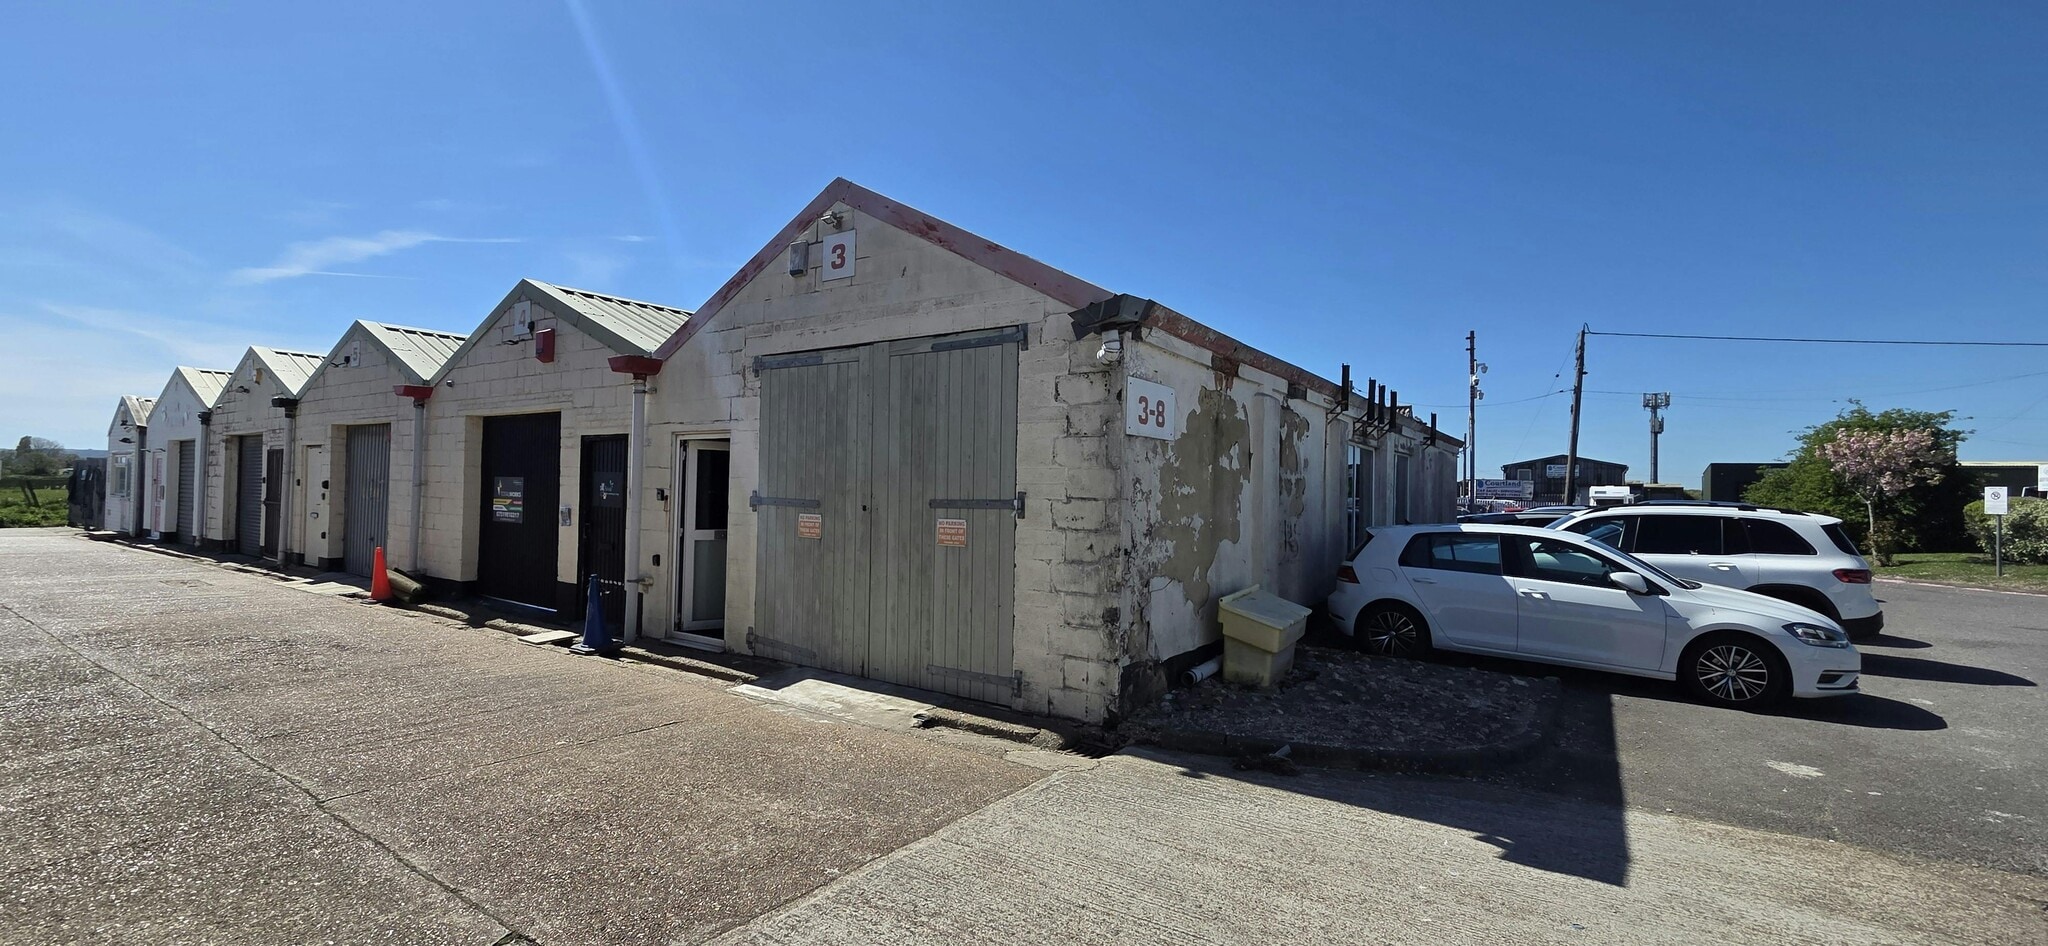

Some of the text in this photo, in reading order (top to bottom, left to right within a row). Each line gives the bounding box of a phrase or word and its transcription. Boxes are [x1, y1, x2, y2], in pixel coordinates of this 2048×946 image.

[831, 243, 846, 270] 3
[519, 310, 526, 327] 4
[1138, 395, 1166, 428] 3-8
